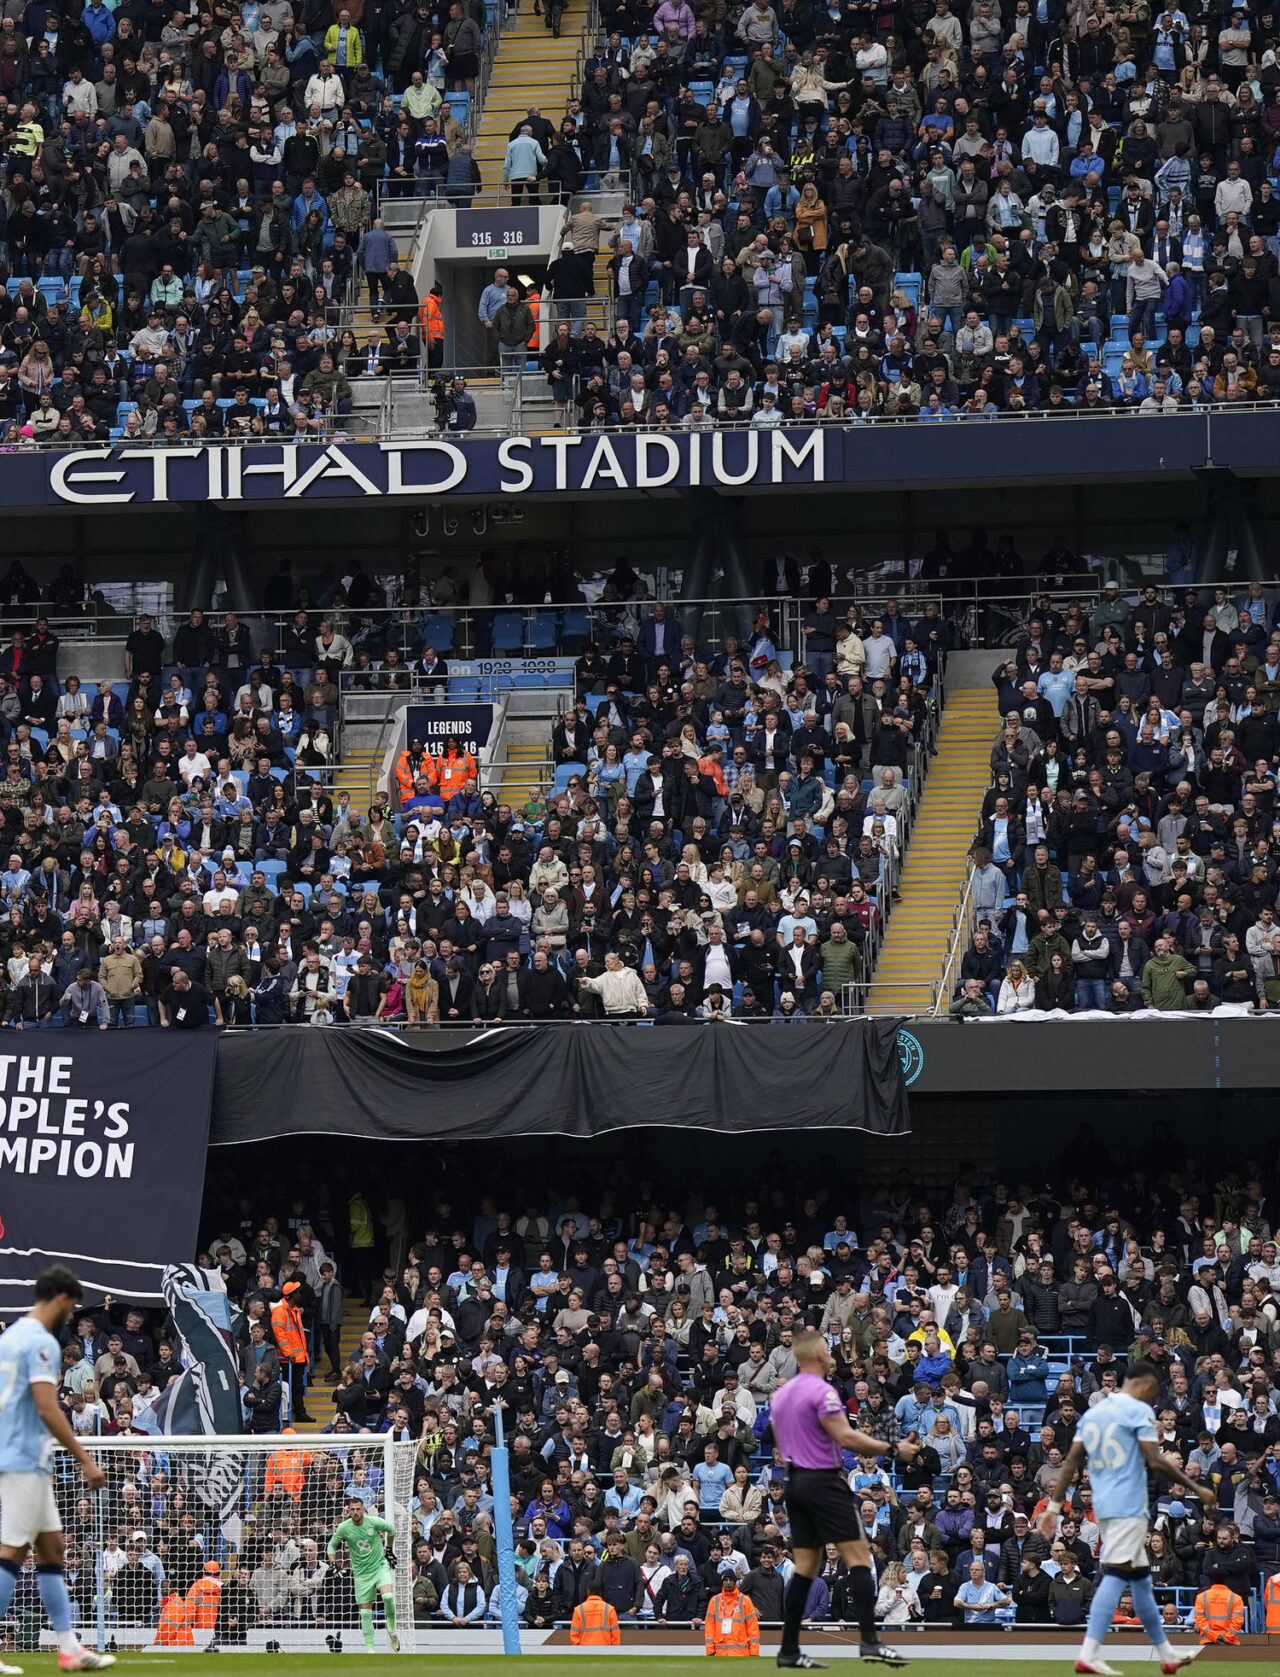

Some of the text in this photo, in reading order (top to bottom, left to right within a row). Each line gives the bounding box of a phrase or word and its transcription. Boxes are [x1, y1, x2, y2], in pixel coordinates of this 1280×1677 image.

[472, 231, 523, 245] 315 316
[49, 428, 825, 504] ETIHAD STADIUM
[427, 720, 473, 735] LEGENDS
[423, 741, 478, 756] 115 16
[1081, 1421, 1126, 1470] 26
